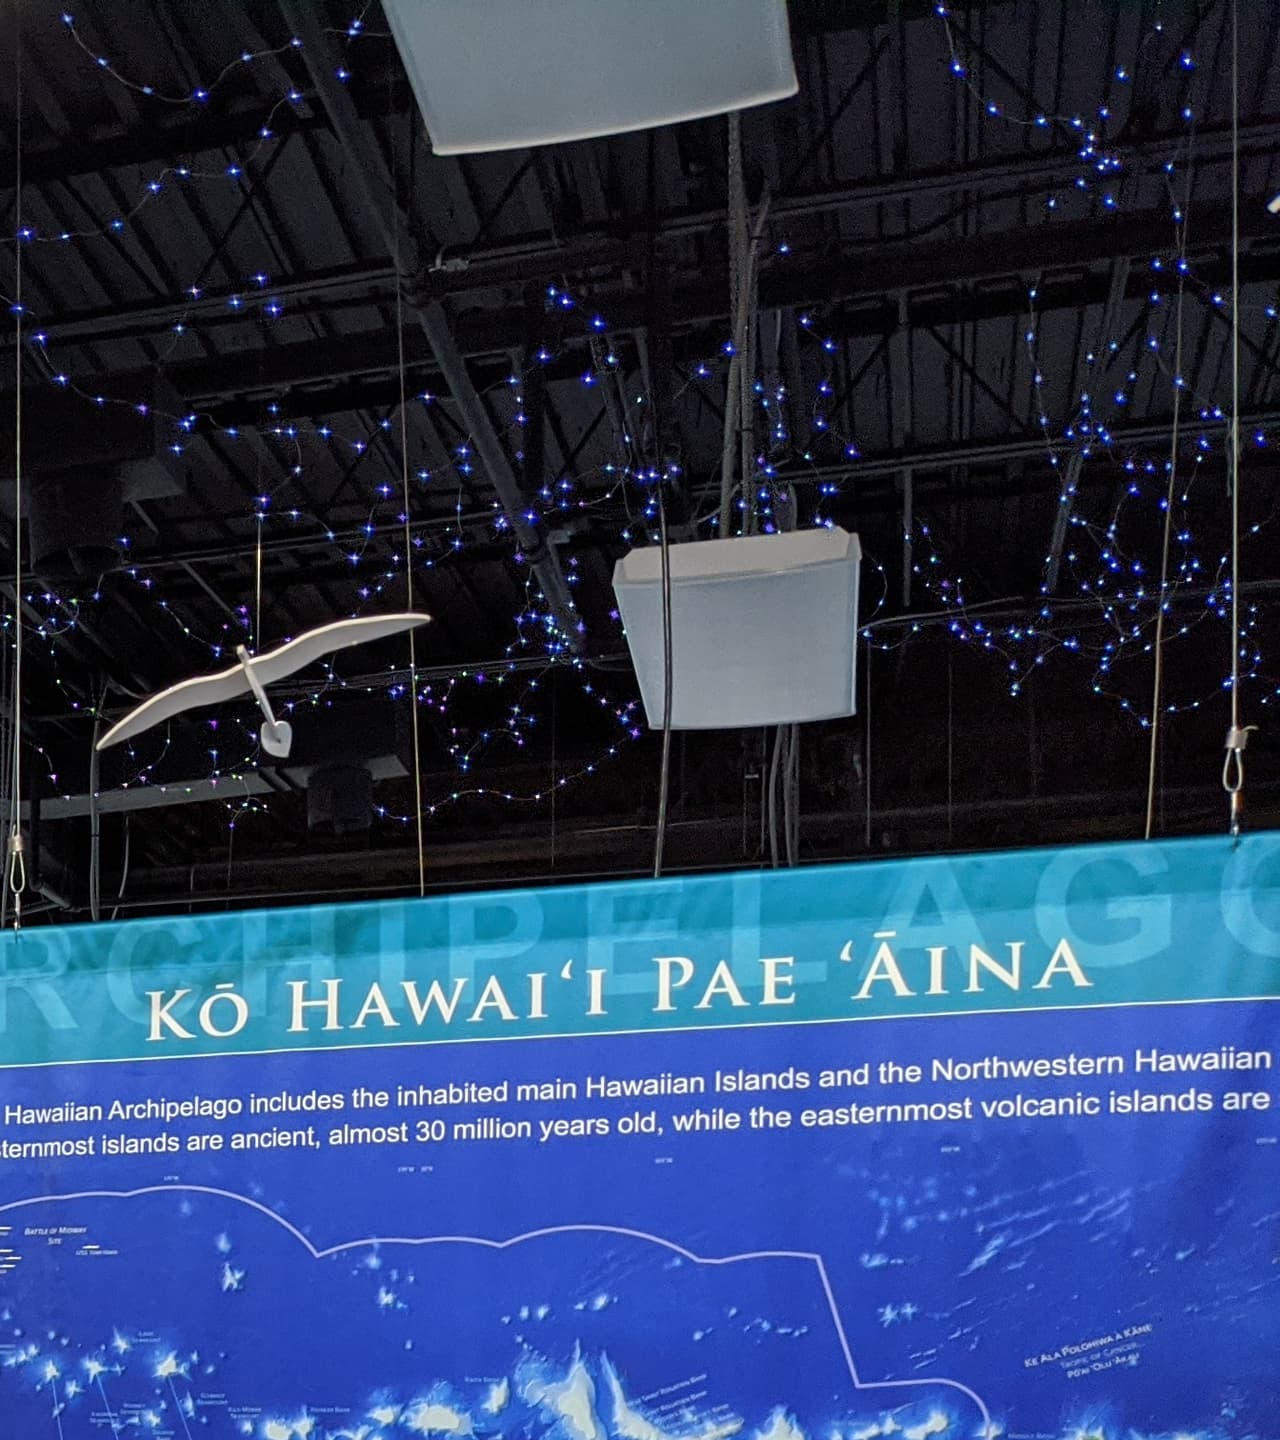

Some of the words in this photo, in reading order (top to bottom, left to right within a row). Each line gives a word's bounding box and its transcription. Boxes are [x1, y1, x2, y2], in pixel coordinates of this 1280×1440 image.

[654, 956, 794, 1012] PAE
[6, 1102, 101, 1125] Hawaiian
[108, 1096, 241, 1122] Archipelago
[251, 1090, 344, 1113] includes
[352, 1087, 388, 1108] the
[398, 1080, 507, 1106] inhabited
[518, 1078, 576, 1101] main
[587, 1073, 704, 1098] Hawaiian
[716, 1067, 809, 1092] Islands
[819, 1063, 868, 1088] and
[879, 1061, 921, 1084] the
[933, 1054, 1123, 1082] Northwestern
[1136, 1046, 1271, 1073] Hawaiian
[103, 1132, 179, 1155] islands
[187, 1134, 223, 1151] are
[231, 1126, 319, 1149] ancient,
[330, 1122, 408, 1145] almost
[416, 1119, 445, 1142] 30
[454, 1117, 530, 1140] million
[540, 1118, 609, 1142] years
[618, 1111, 662, 1135] old,
[673, 1108, 740, 1131] while
[750, 1106, 791, 1129] the
[801, 1097, 972, 1127] easternmost
[982, 1092, 1099, 1118] volcanic
[1110, 1088, 1212, 1113] islands
[1223, 1092, 1270, 1110] are
